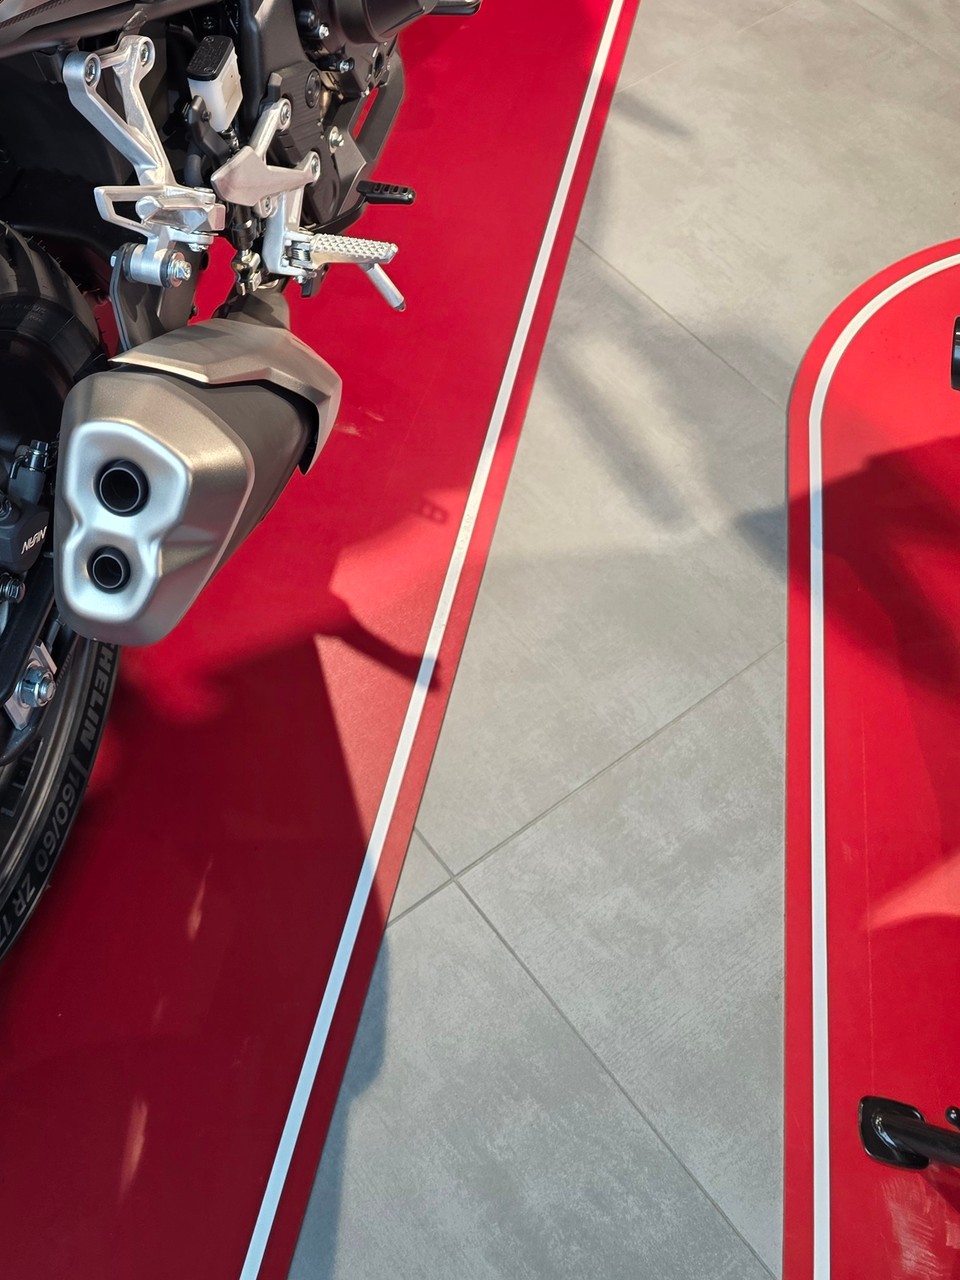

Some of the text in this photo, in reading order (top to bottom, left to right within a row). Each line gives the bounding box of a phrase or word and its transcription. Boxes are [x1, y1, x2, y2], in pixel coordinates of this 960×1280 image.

[78, 644, 117, 753] HELIN
[38, 773, 82, 873] 160/60
[11, 876, 37, 915] ZR
